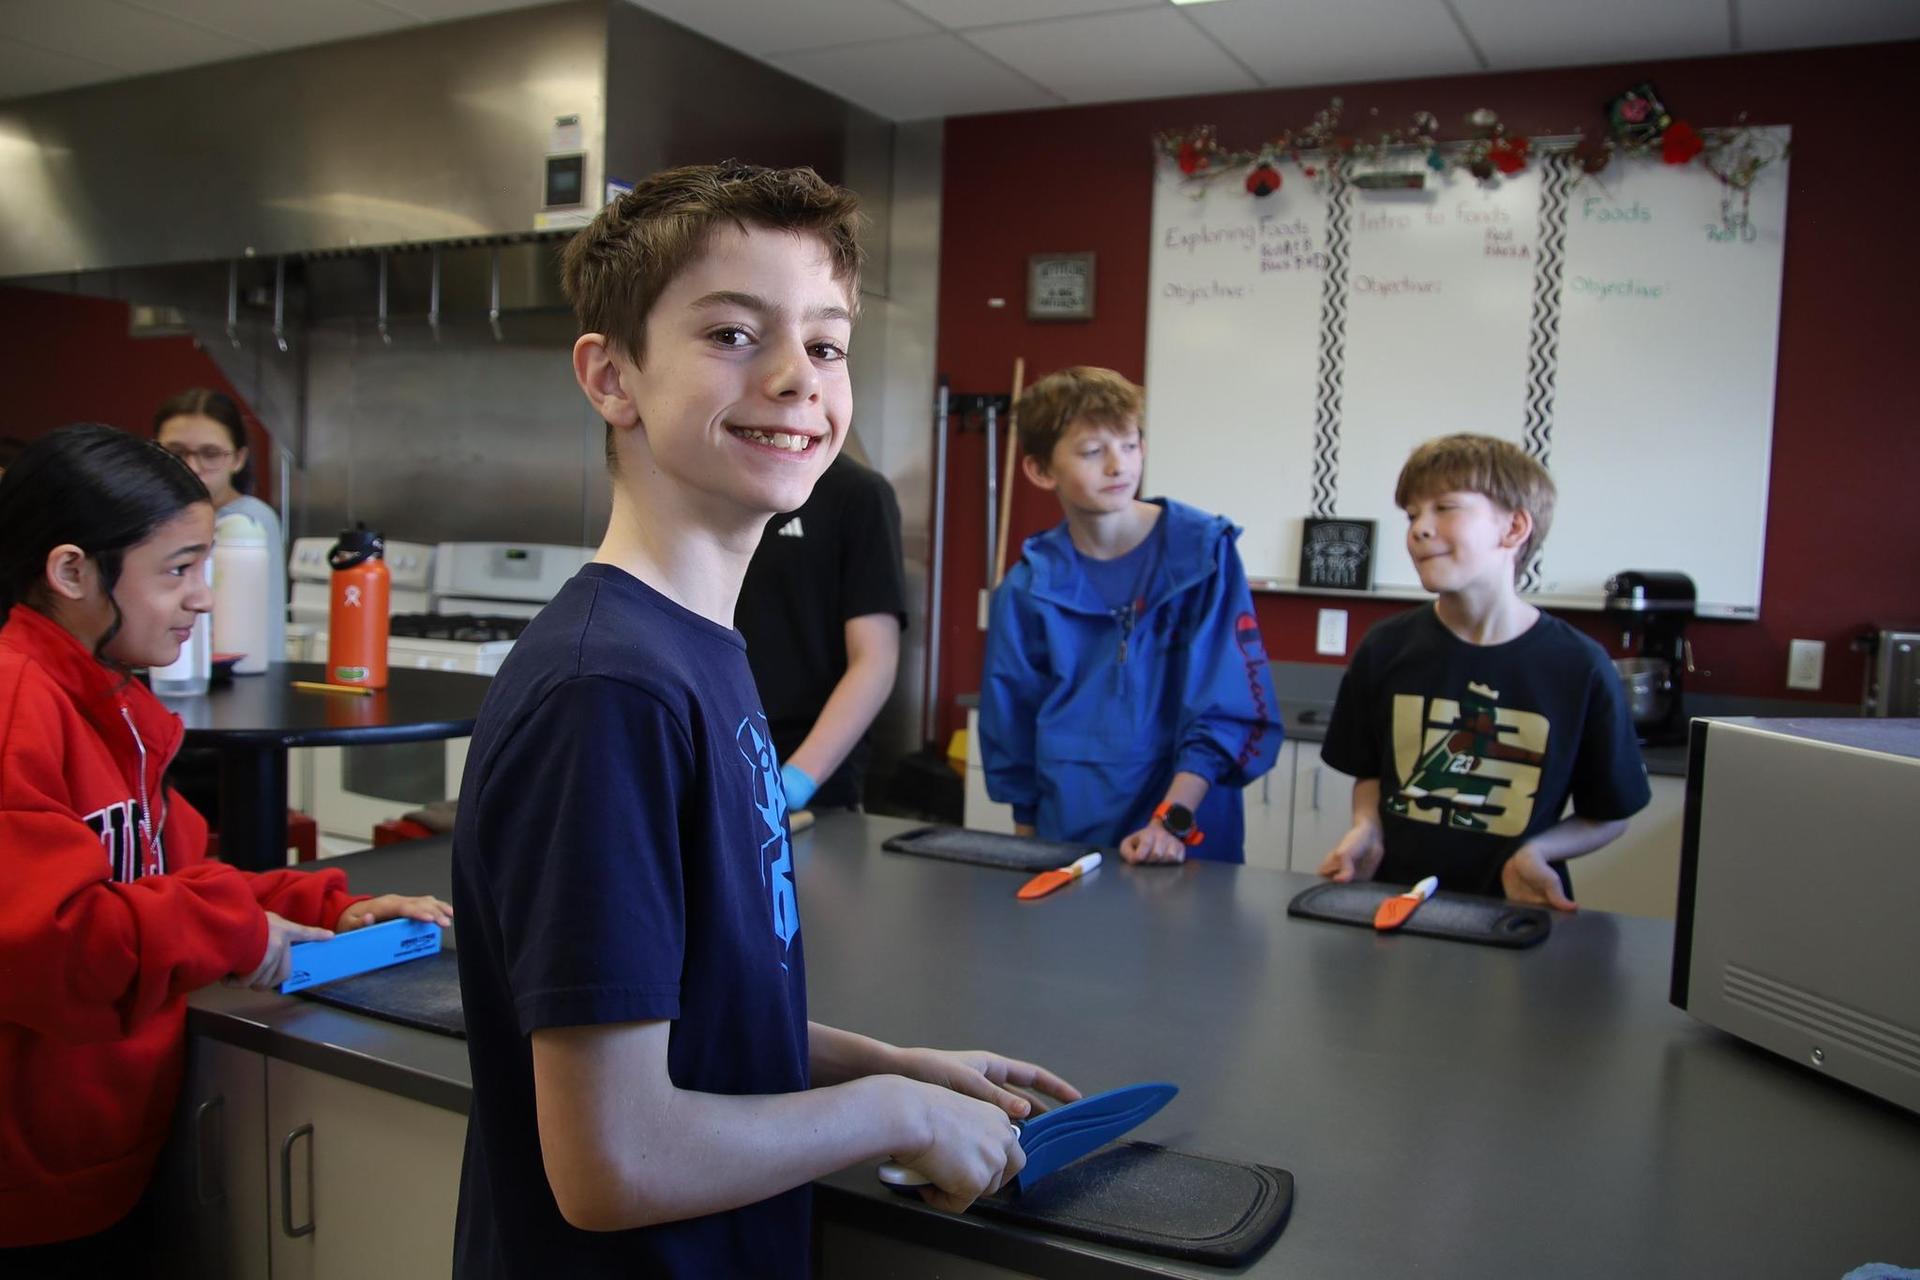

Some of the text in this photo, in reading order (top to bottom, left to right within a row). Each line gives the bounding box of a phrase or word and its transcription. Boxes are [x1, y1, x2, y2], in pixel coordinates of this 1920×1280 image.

[1359, 206, 1410, 232] Intro
[1583, 197, 1652, 224] Foods
[1164, 214, 1311, 254] Exploring Foods
